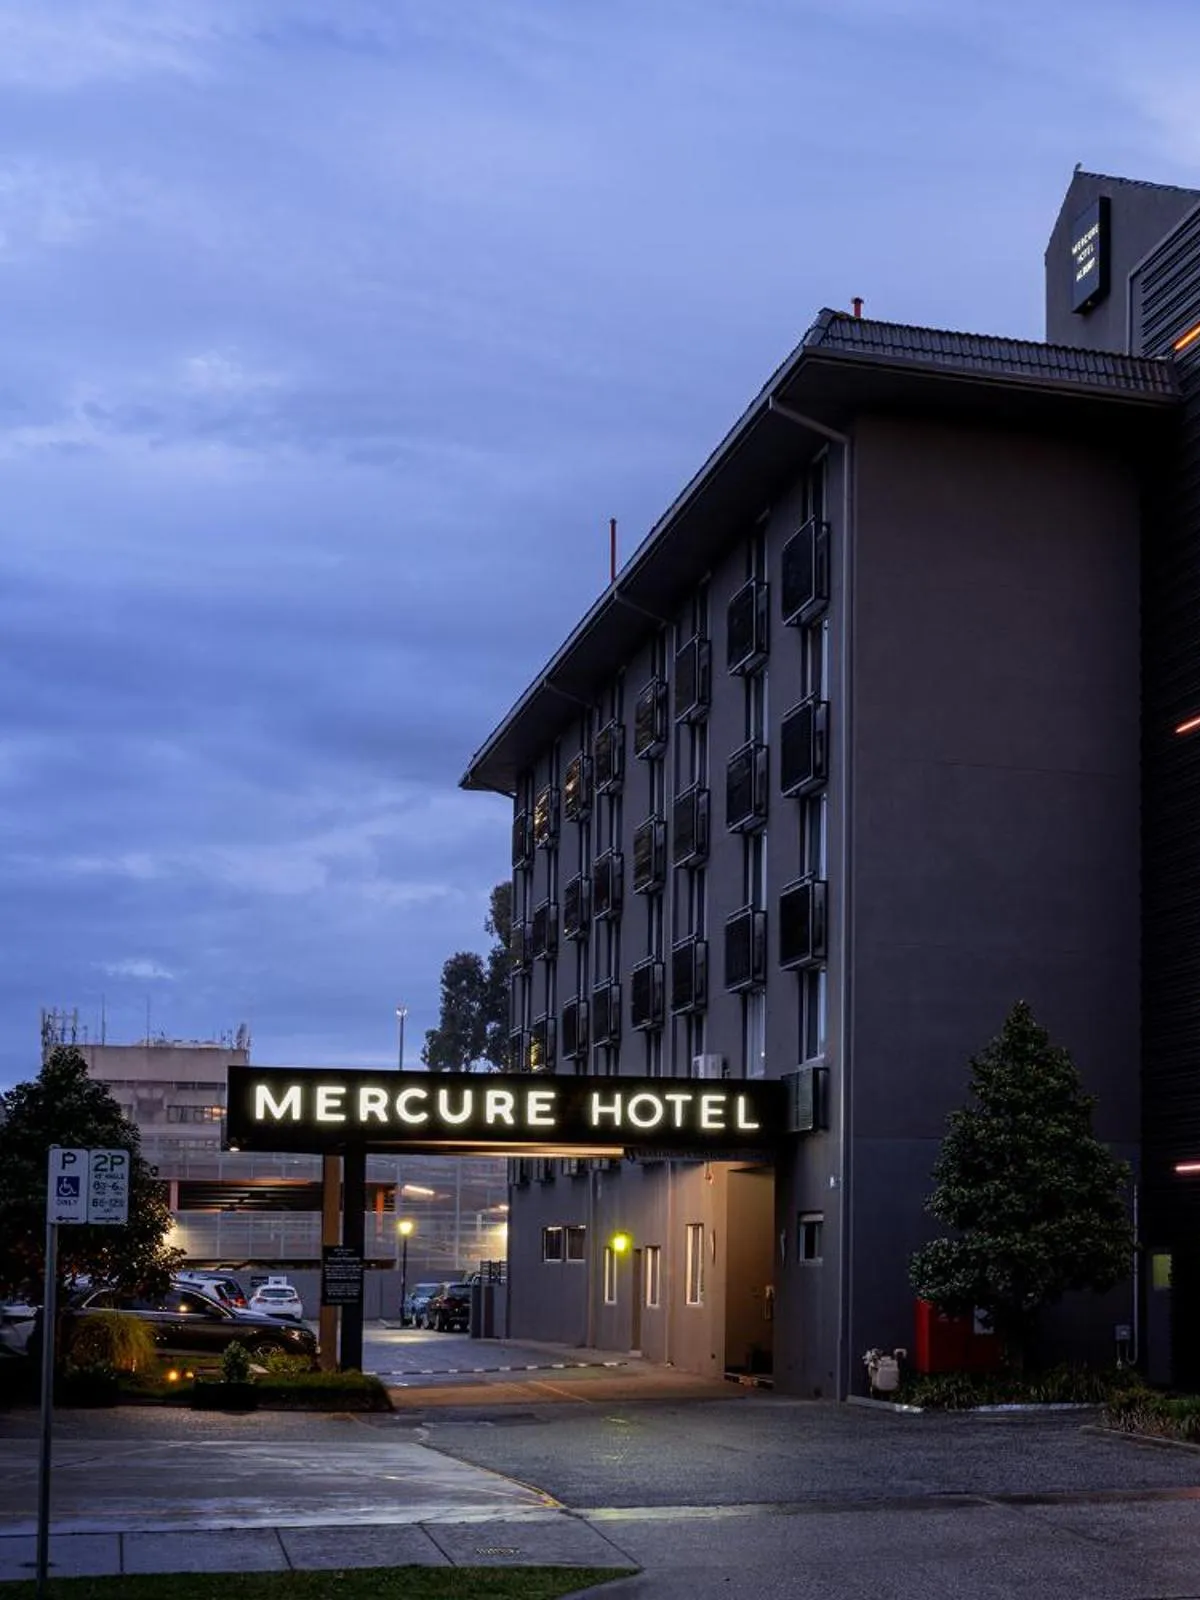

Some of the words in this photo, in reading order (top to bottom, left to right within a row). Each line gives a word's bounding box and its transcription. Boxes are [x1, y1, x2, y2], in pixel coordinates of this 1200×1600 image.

[254, 1084, 558, 1128] MERCURE
[591, 1092, 762, 1131] HOTEL
[62, 1153, 77, 1170] P
[93, 1153, 125, 1172] 2P
